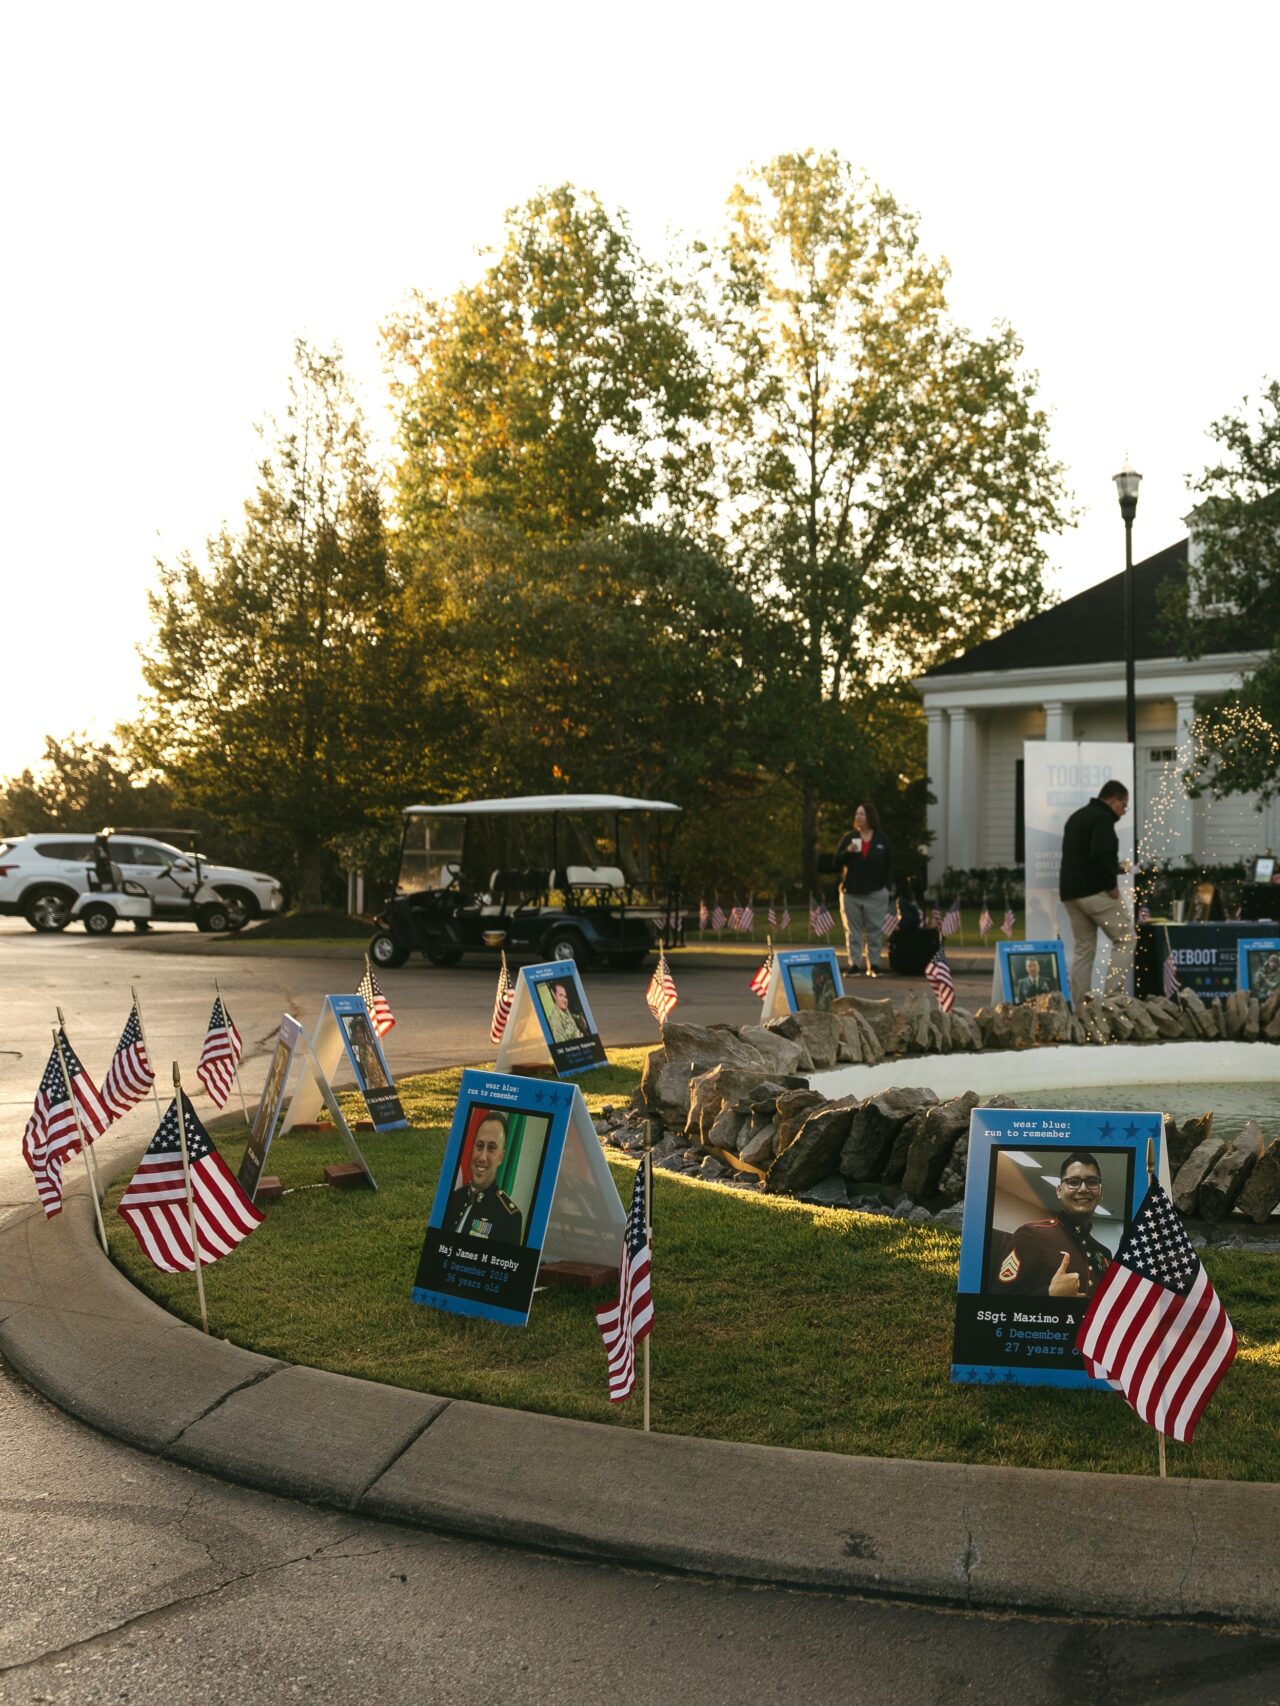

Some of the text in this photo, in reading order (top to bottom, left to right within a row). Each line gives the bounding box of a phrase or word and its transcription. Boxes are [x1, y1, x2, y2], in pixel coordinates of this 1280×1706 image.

[1172, 949, 1217, 965] REBOOT
[486, 1082, 519, 1092] wear blue:
[490, 1092, 518, 1101] remember
[1042, 1120, 1070, 1128] blue:
[1023, 1130, 1071, 1138] remember
[439, 1244, 519, 1272] Maj James M Brophy
[451, 1262, 486, 1277] December
[489, 1270, 509, 1282] 2018
[458, 1278, 481, 1289] years
[484, 1283, 500, 1293] old
[976, 1310, 1075, 1324] SSgt Maximo A
[995, 1328, 1069, 1340] 6 December
[1005, 1342, 1020, 1352] 27
[1026, 1345, 1064, 1356] years
